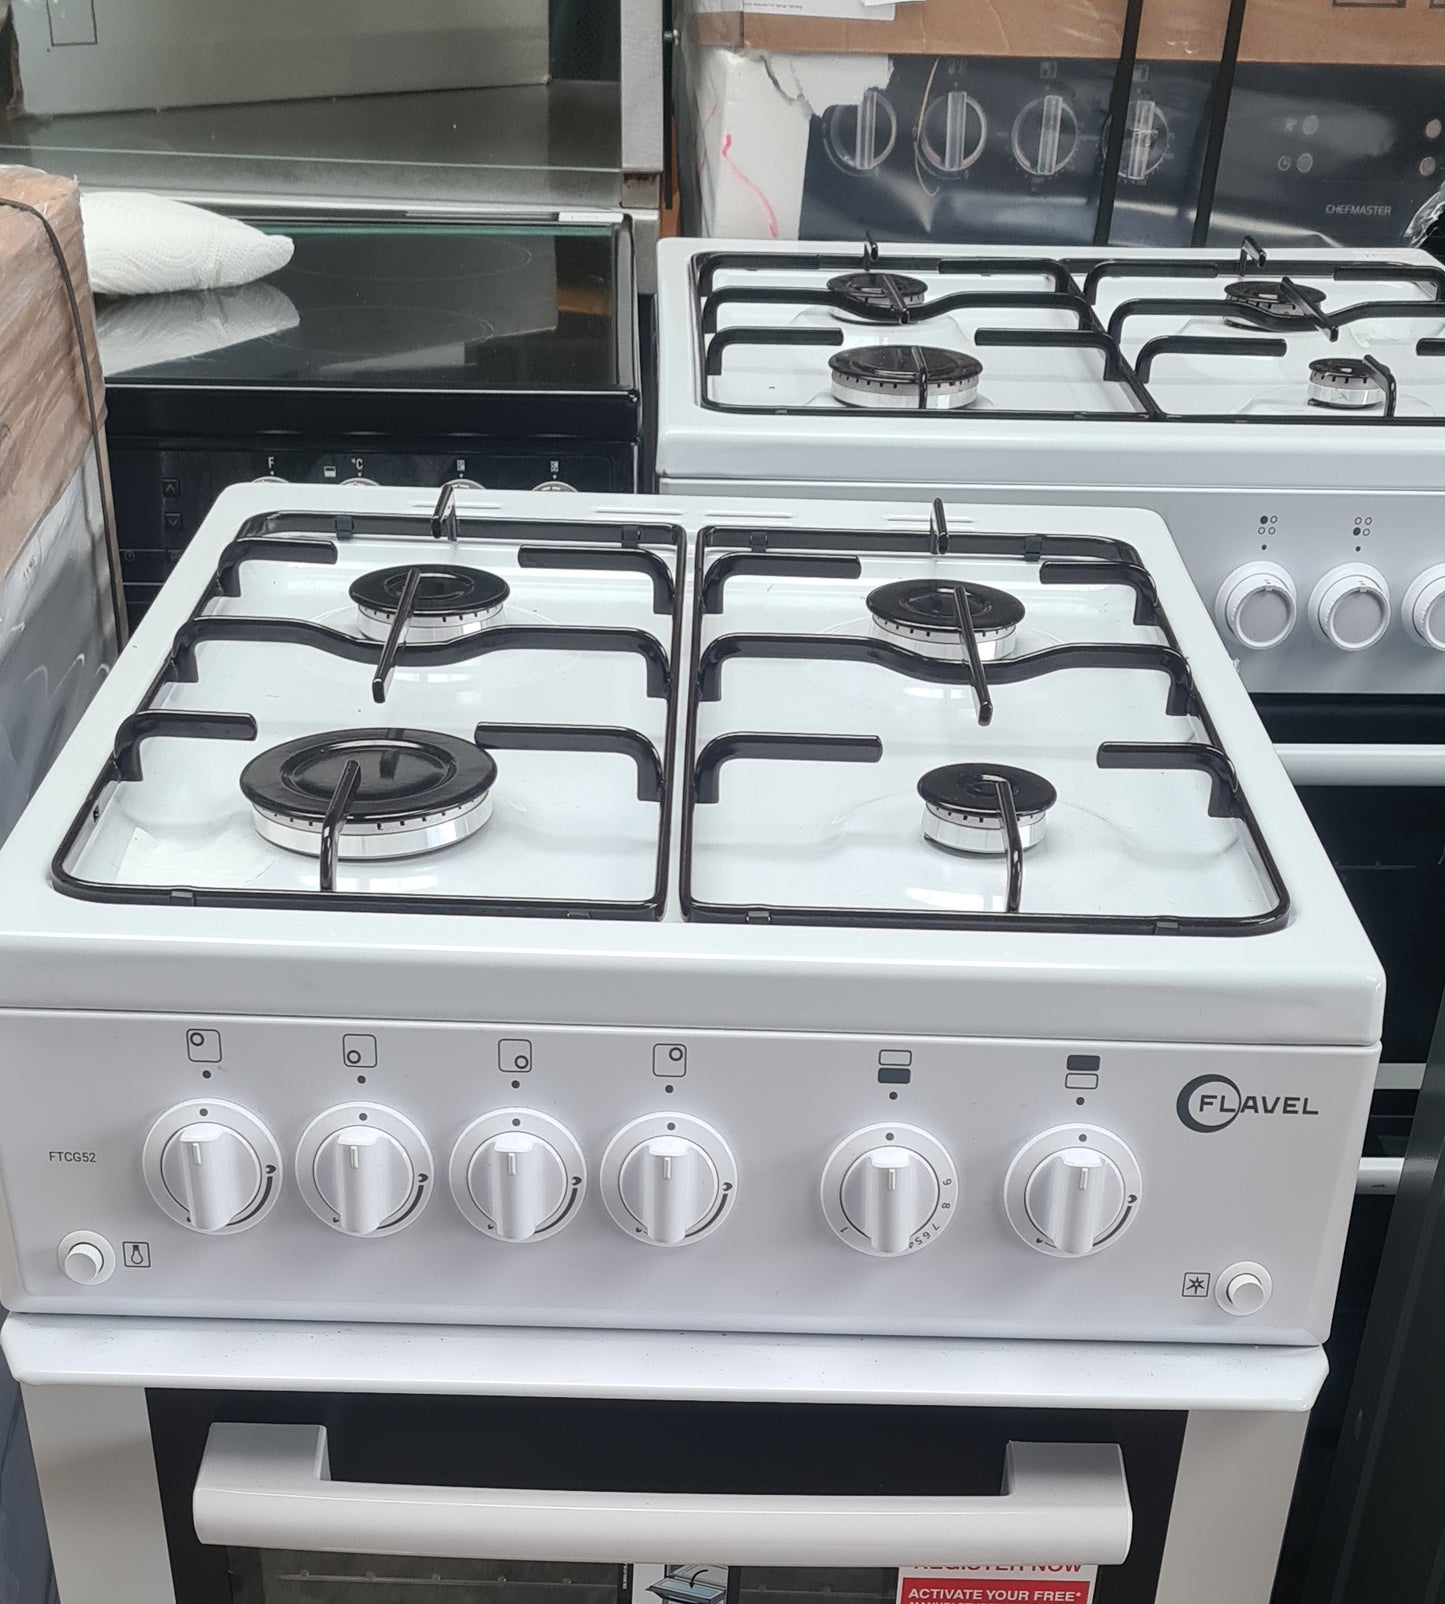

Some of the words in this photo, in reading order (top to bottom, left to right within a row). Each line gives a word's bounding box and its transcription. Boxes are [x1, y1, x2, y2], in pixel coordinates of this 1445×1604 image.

[1326, 204, 1392, 216] CHEFMASTER
[1199, 1094, 1319, 1115] FLAVEL
[49, 1151, 97, 1163] FTCG52
[908, 1588, 983, 1600] ACTIVATE
[986, 1590, 1029, 1601] YOUR
